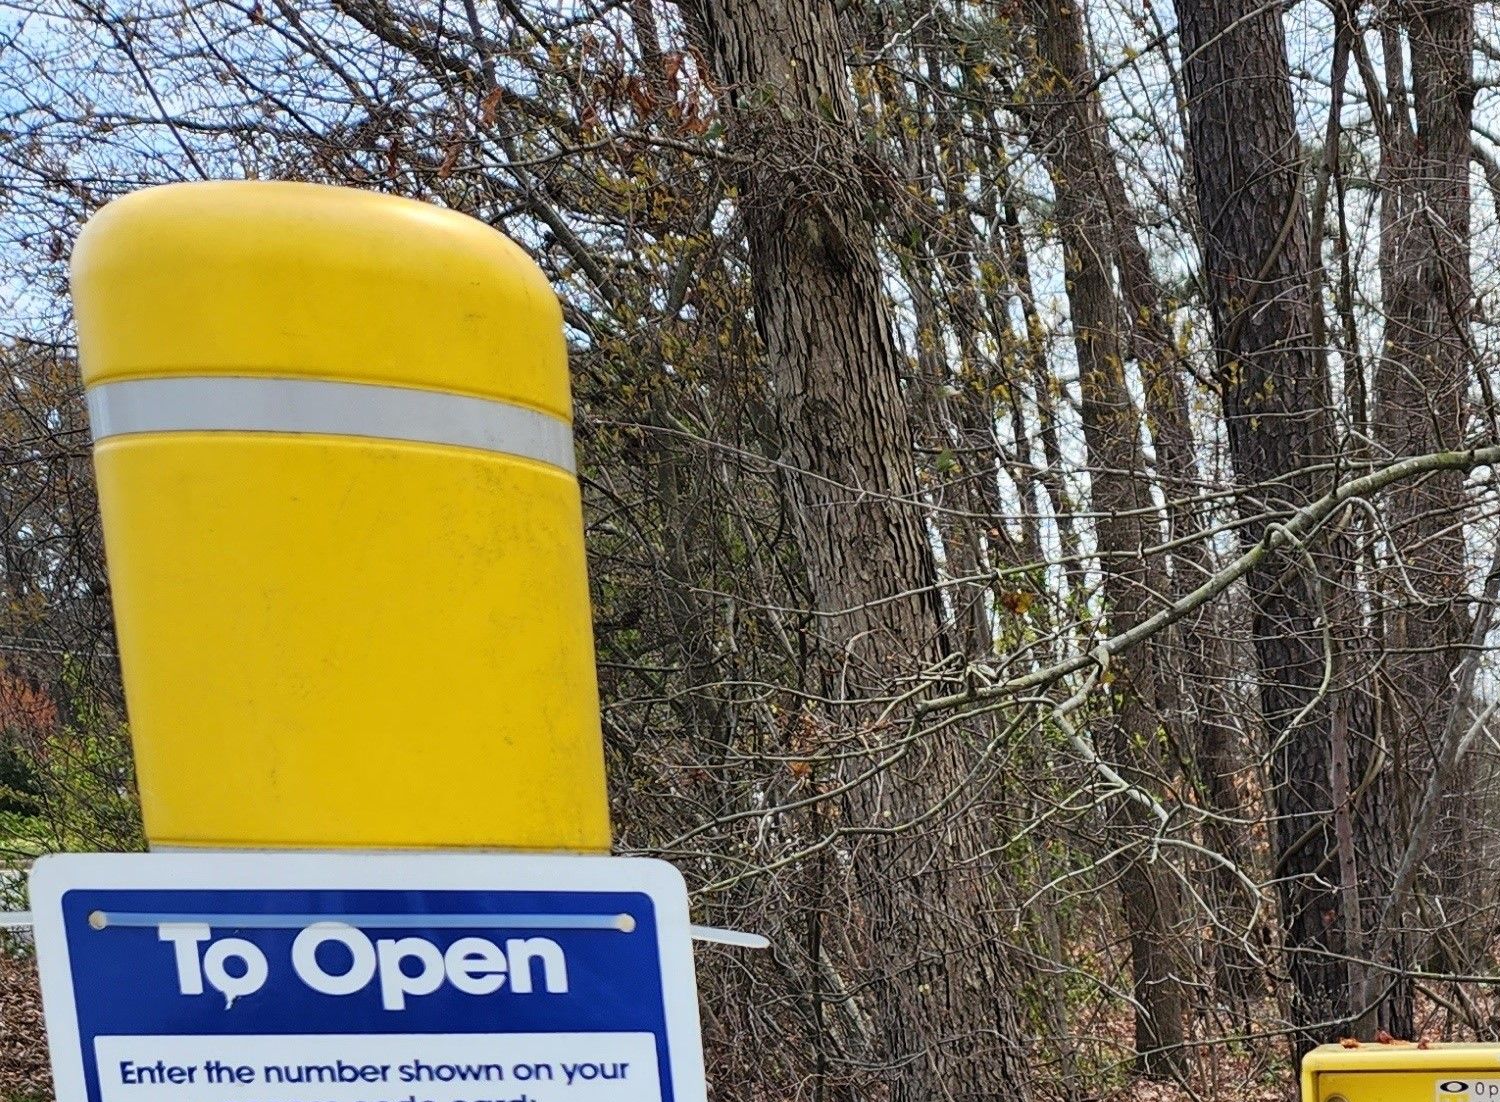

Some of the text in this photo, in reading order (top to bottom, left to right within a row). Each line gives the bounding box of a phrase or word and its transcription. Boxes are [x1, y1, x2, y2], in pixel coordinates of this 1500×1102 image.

[158, 921, 570, 1011] To Open
[119, 1059, 629, 1085] Enter the number shown on your
